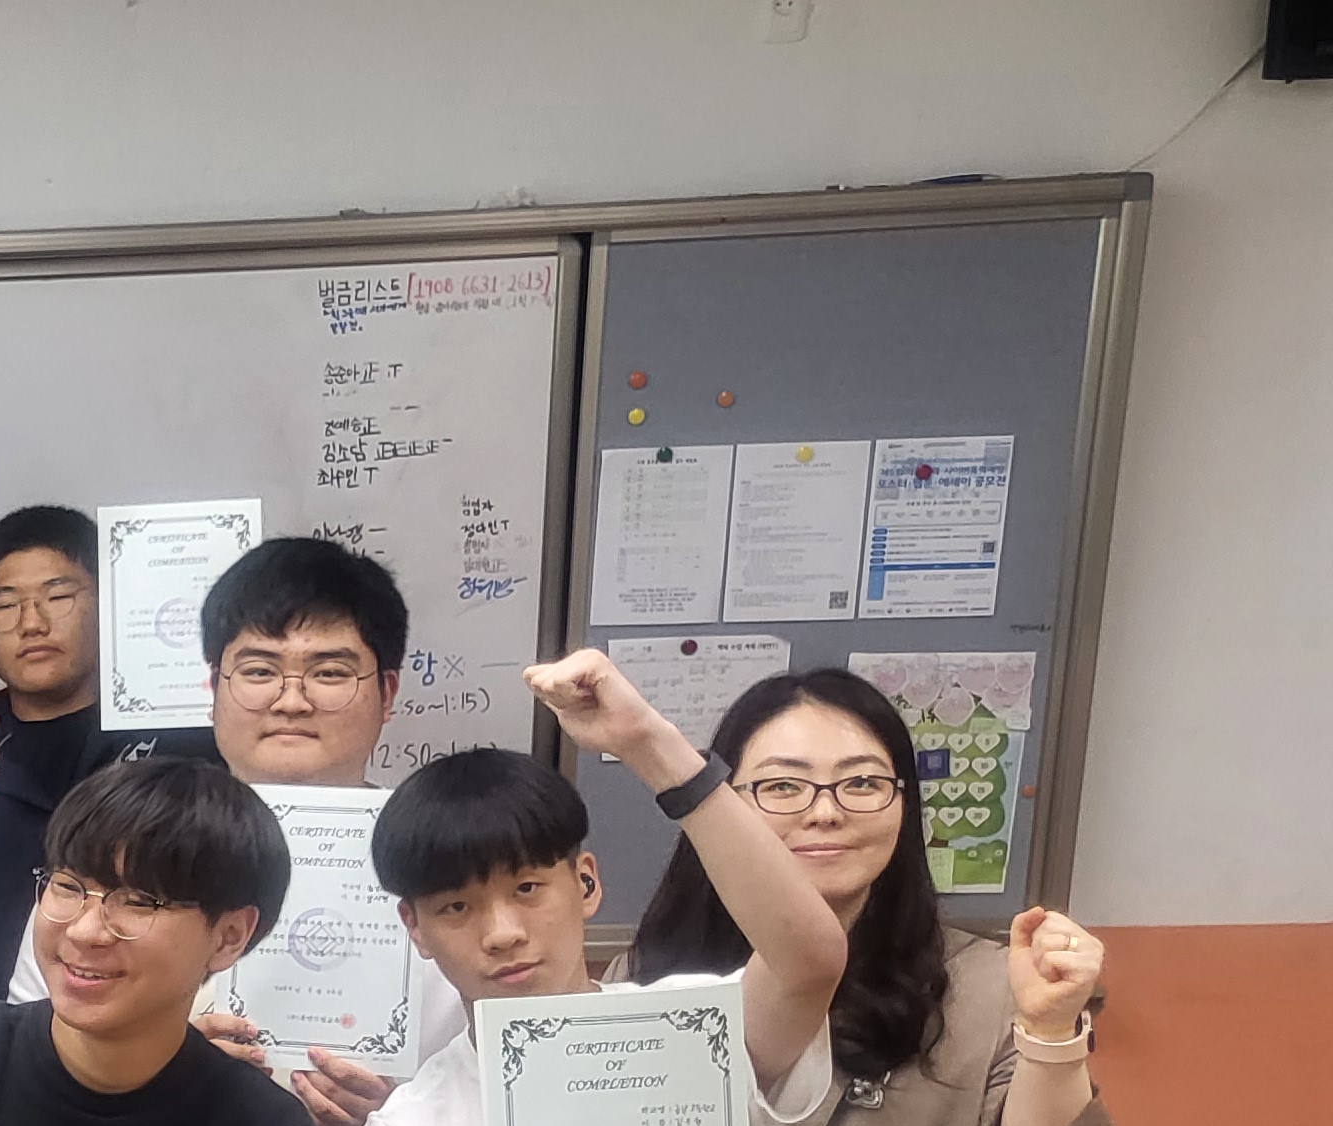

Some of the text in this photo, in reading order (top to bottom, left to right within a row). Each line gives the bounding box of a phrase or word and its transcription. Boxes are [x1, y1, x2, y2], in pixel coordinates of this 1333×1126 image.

[289, 826, 367, 839] CERTIFICATE
[318, 842, 336, 852] OF
[565, 1038, 664, 1056] CERTIFICATE
[605, 1059, 626, 1072] OF
[567, 1074, 668, 1093] COMPLETION
